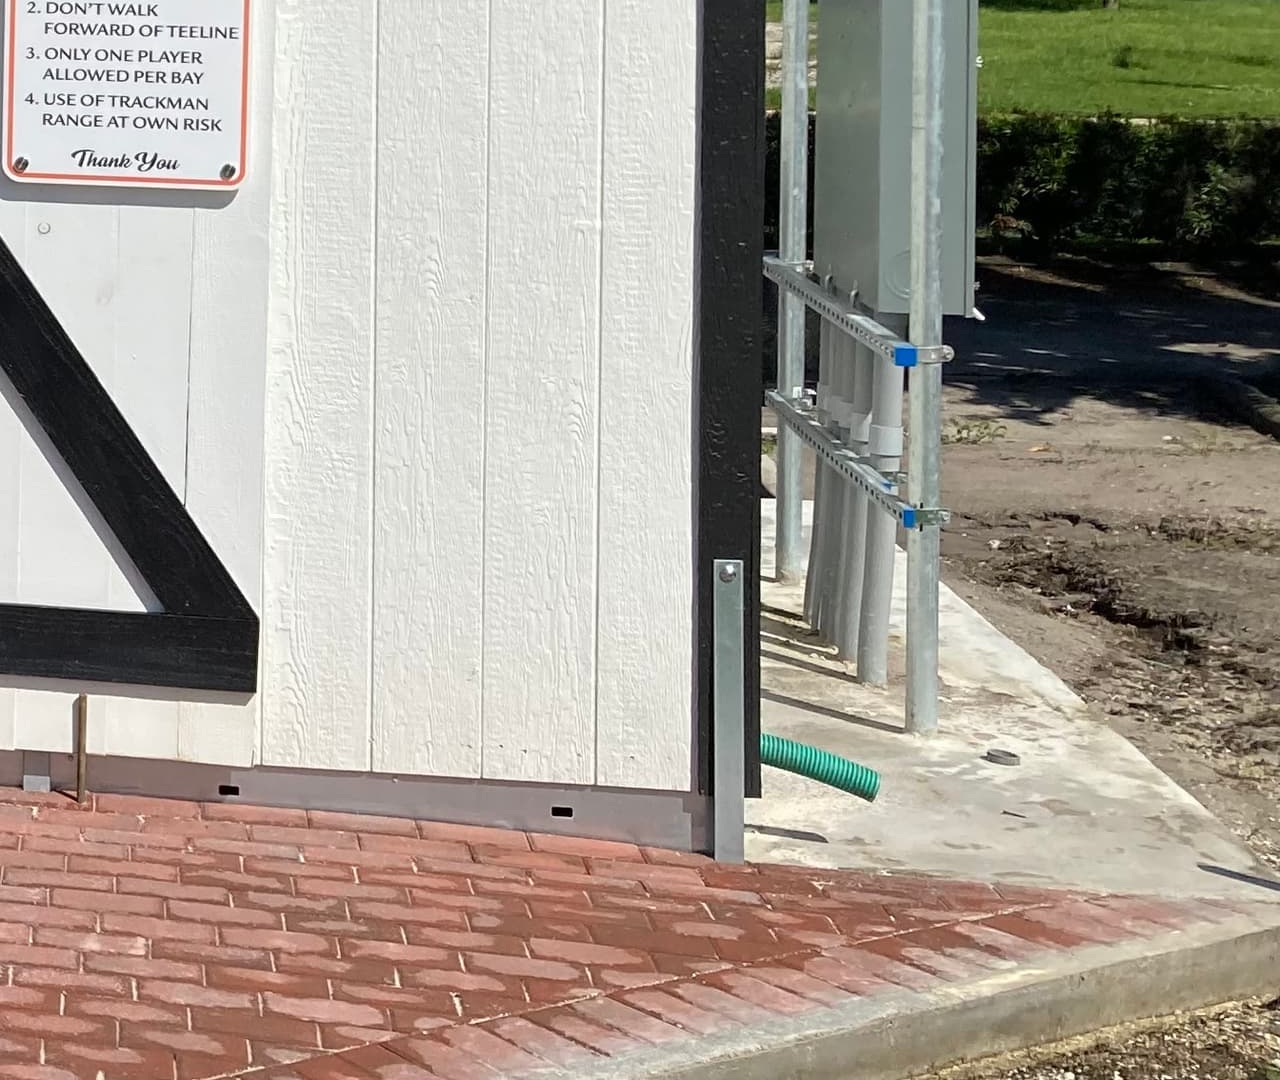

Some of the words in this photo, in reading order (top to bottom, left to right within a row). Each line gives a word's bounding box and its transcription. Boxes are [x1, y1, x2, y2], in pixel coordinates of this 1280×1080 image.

[26, 1, 41, 15] 2.
[107, 3, 159, 17] WALK
[44, 22, 135, 38] FORWARD
[139, 25, 164, 38] OF
[167, 25, 239, 40] TEELINE
[25, 47, 40, 61] 3.
[44, 47, 91, 62] ONLY
[94, 48, 134, 63] ONE
[138, 49, 203, 64] PLAYER
[42, 68, 129, 84] ALLOWED
[133, 70, 167, 85] PER
[171, 71, 205, 86] BAY
[25, 92, 39, 106] 4.
[43, 93, 76, 107] USE
[80, 94, 105, 108] OF
[108, 95, 209, 110] TRACKMAN
[42, 113, 103, 129] RANGE
[106, 115, 129, 129] AT
[133, 116, 179, 131] OWN
[183, 117, 223, 132] RISK
[71, 149, 133, 169] Thank
[134, 151, 180, 172] You
